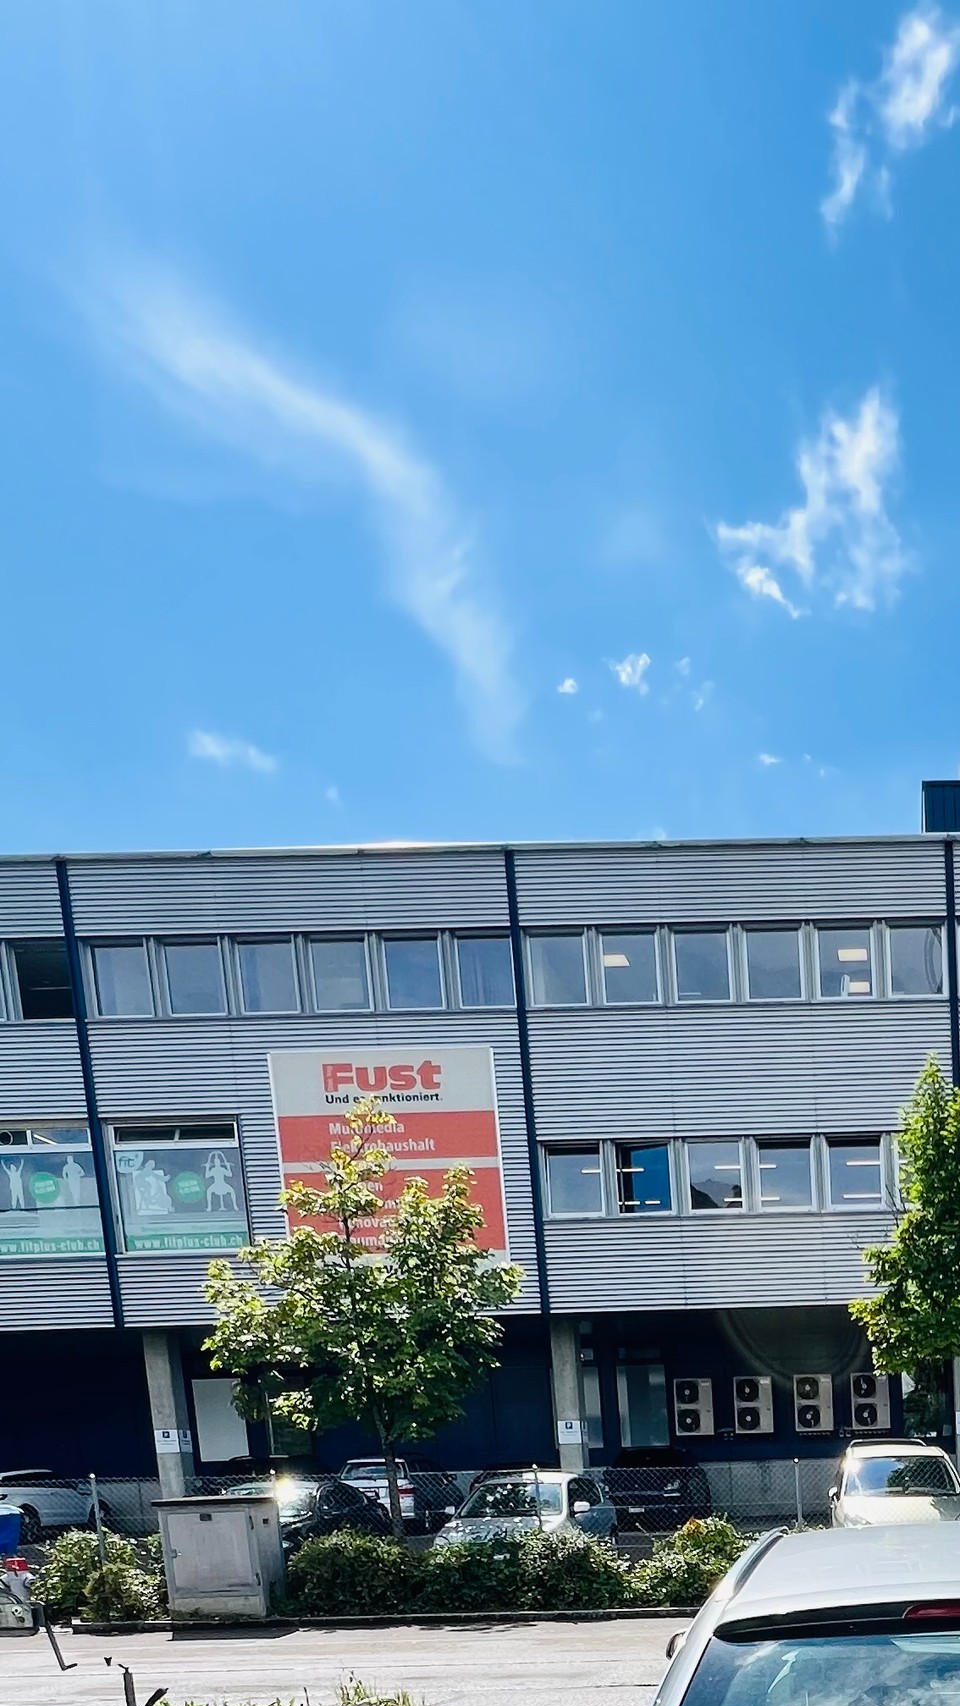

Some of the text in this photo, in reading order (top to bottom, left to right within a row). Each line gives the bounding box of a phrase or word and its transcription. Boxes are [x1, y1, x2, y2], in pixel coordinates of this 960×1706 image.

[322, 1060, 442, 1093] Fust
[325, 1094, 350, 1104] Und
[330, 1138, 436, 1154] Elekrohaushalt
